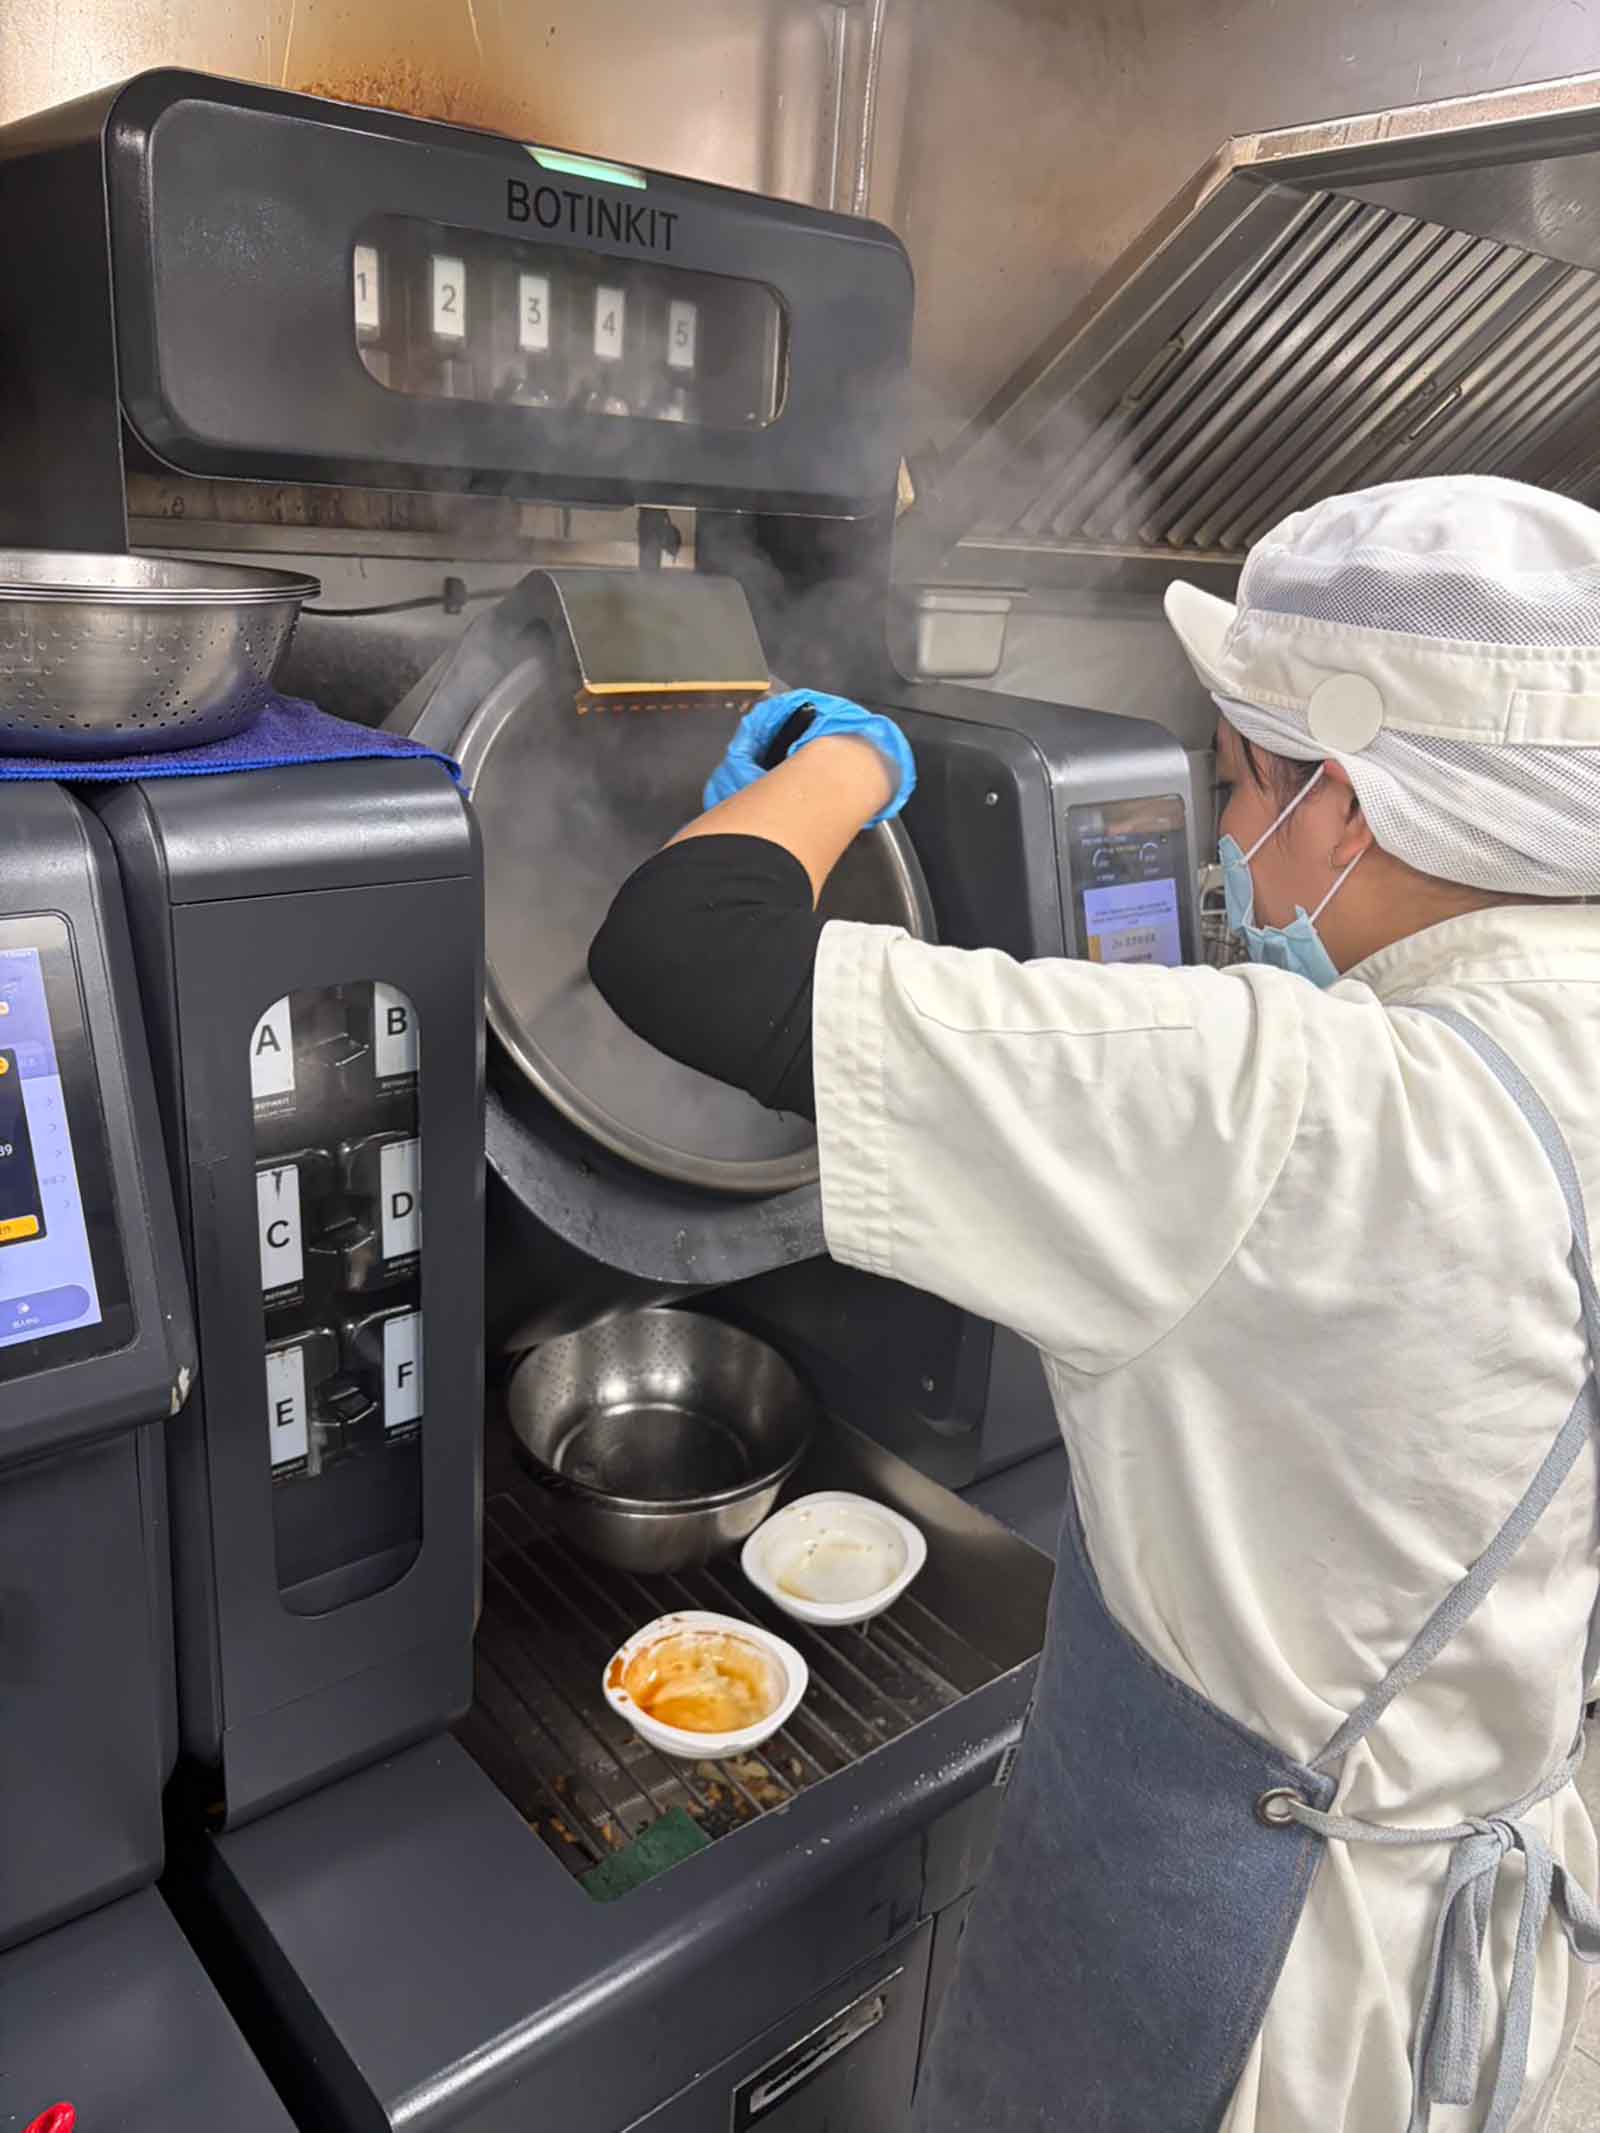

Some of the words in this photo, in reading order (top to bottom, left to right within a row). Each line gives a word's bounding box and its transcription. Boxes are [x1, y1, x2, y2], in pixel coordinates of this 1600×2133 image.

[507, 179, 678, 251] BOTINKIT
[356, 271, 368, 302] 1
[441, 283, 456, 313] 2
[527, 297, 541, 325] 3
[602, 311, 617, 337] 4
[675, 320, 689, 348] 5
[387, 1006, 407, 1035] B
[255, 1024, 281, 1056] A
[391, 1192, 413, 1220] D
[267, 1220, 290, 1249] C
[397, 1361, 414, 1389] F
[275, 1399, 294, 1428] E
